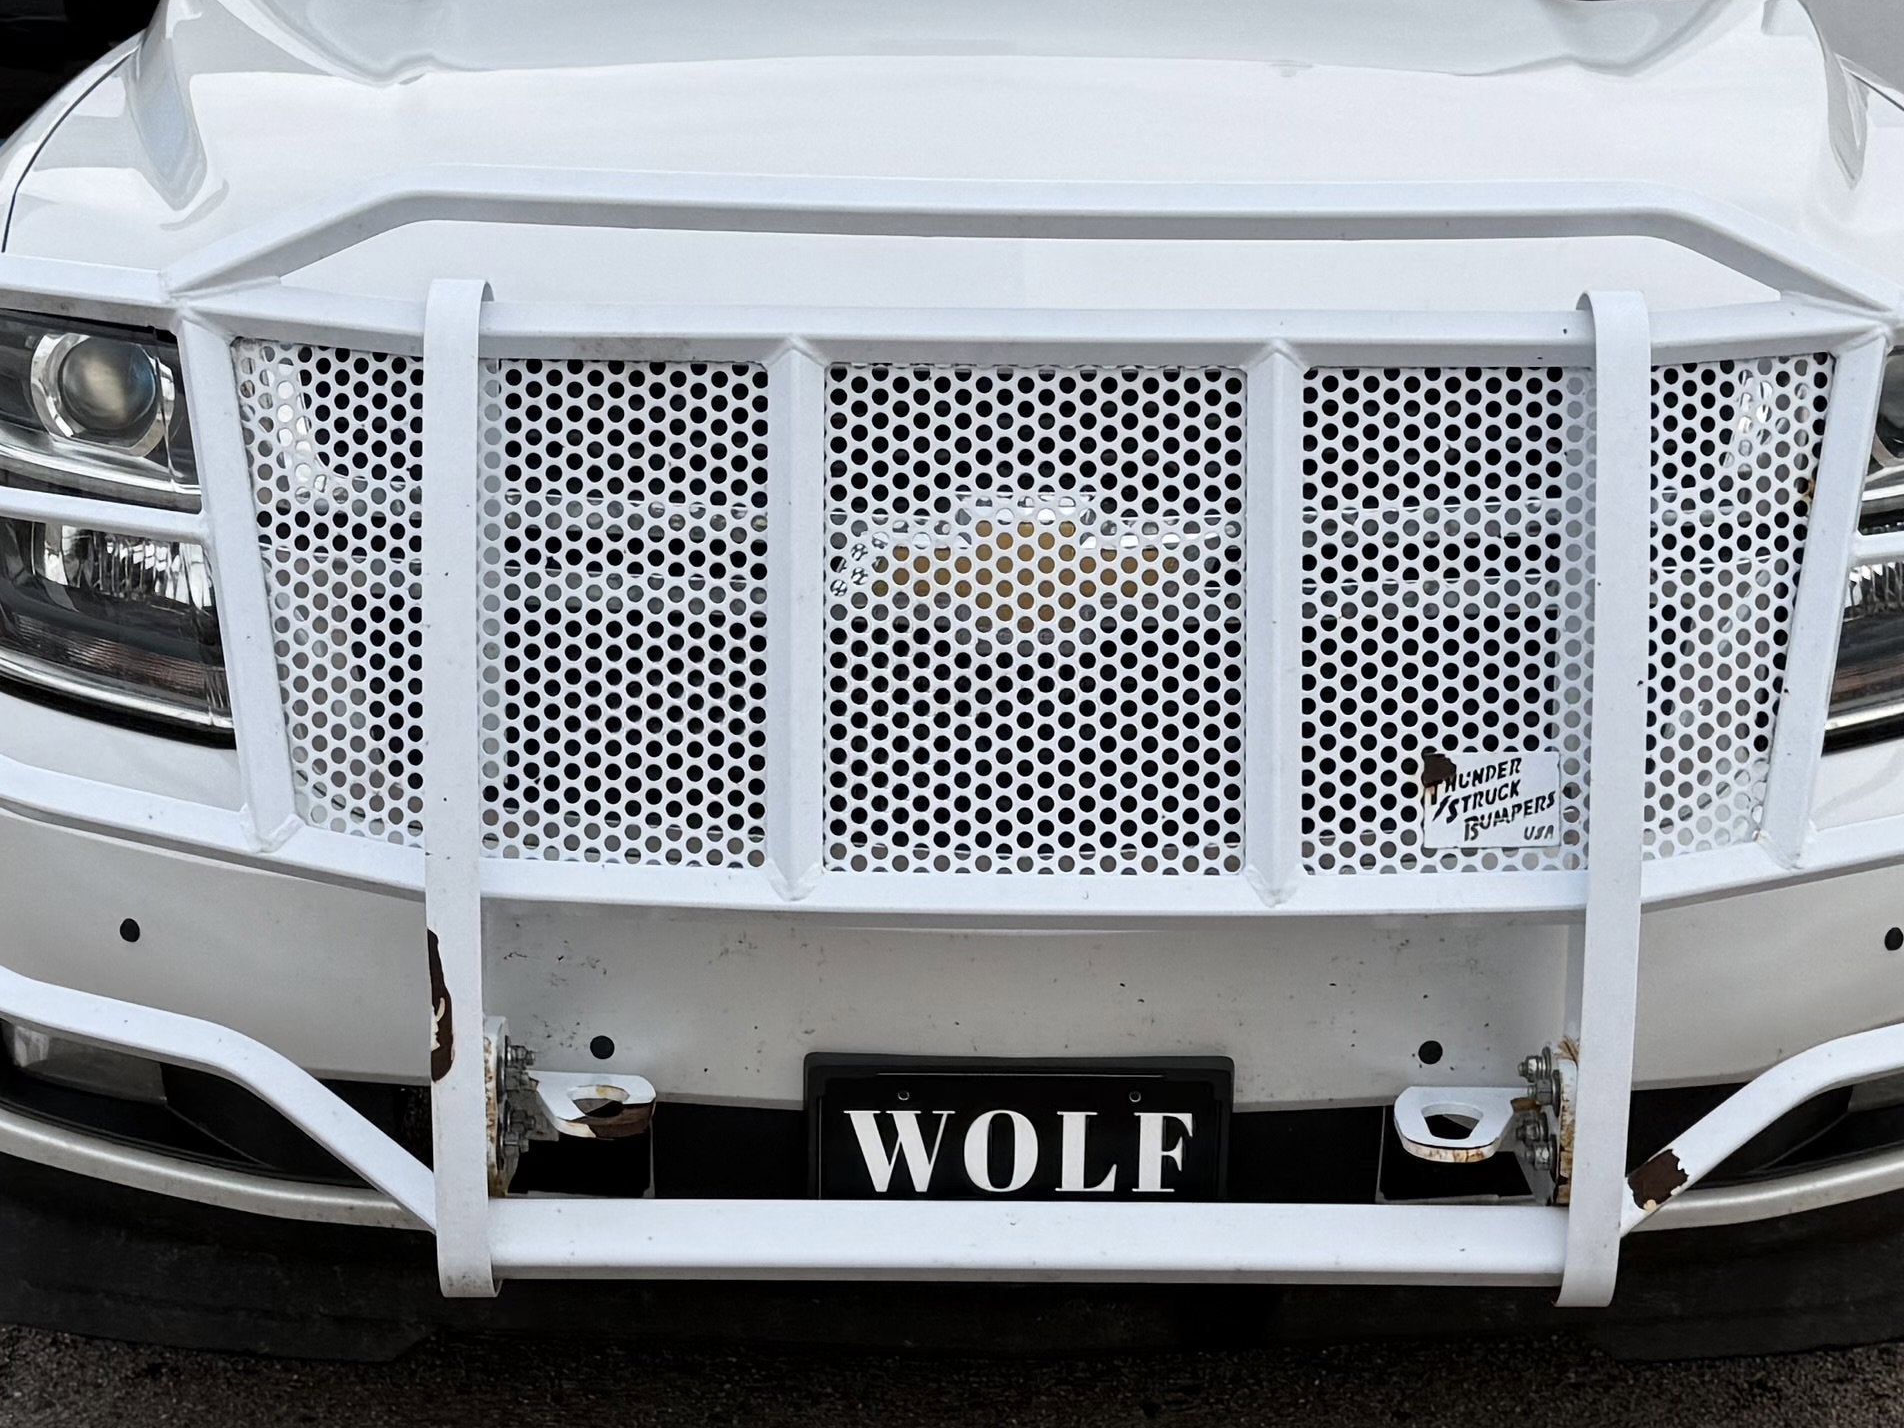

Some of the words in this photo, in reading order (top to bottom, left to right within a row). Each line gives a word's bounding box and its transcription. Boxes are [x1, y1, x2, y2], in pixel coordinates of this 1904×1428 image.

[1438, 779, 1521, 824] STRUCK
[1464, 790, 1556, 842] BUMPERS
[1524, 824, 1554, 841] USA
[843, 1109, 1194, 1194] WOLF
